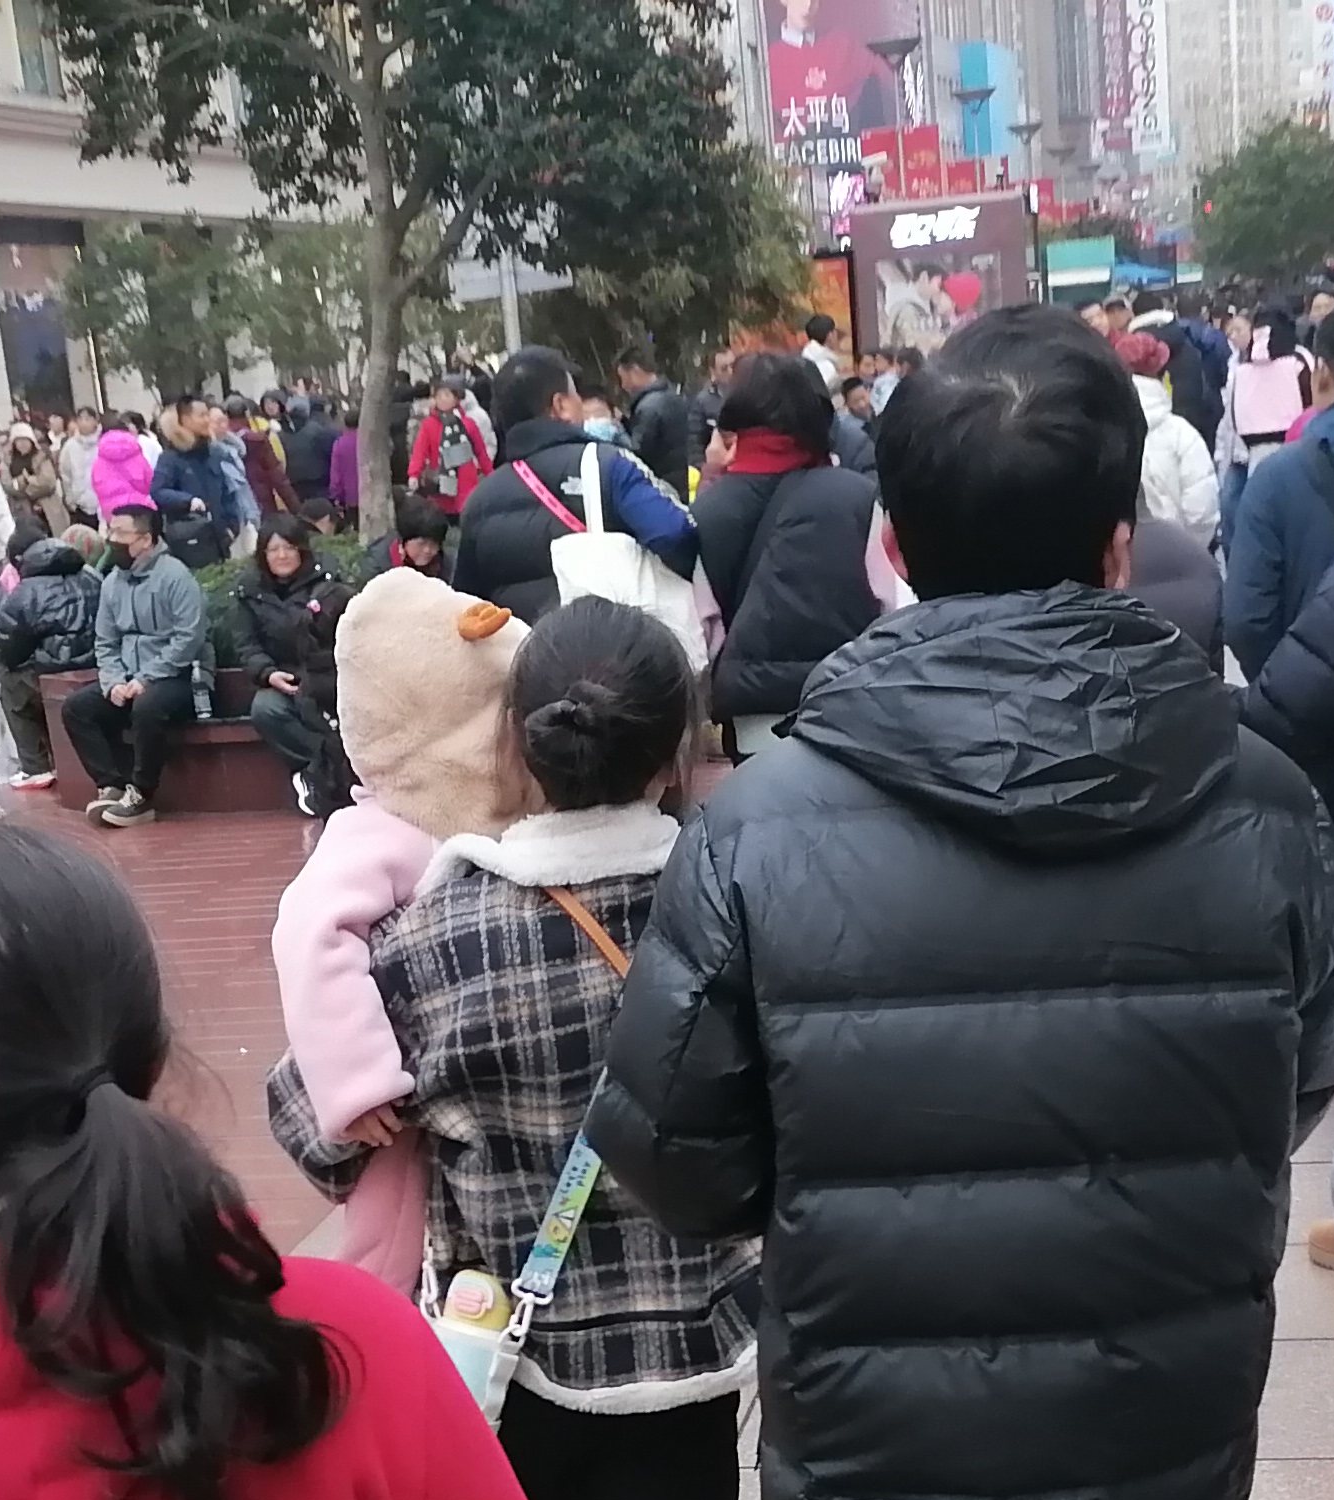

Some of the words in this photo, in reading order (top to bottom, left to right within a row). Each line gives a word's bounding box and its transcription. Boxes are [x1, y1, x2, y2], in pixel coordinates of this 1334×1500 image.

[781, 93, 849, 137] 太平鸟
[774, 137, 861, 165] EACEBIR
